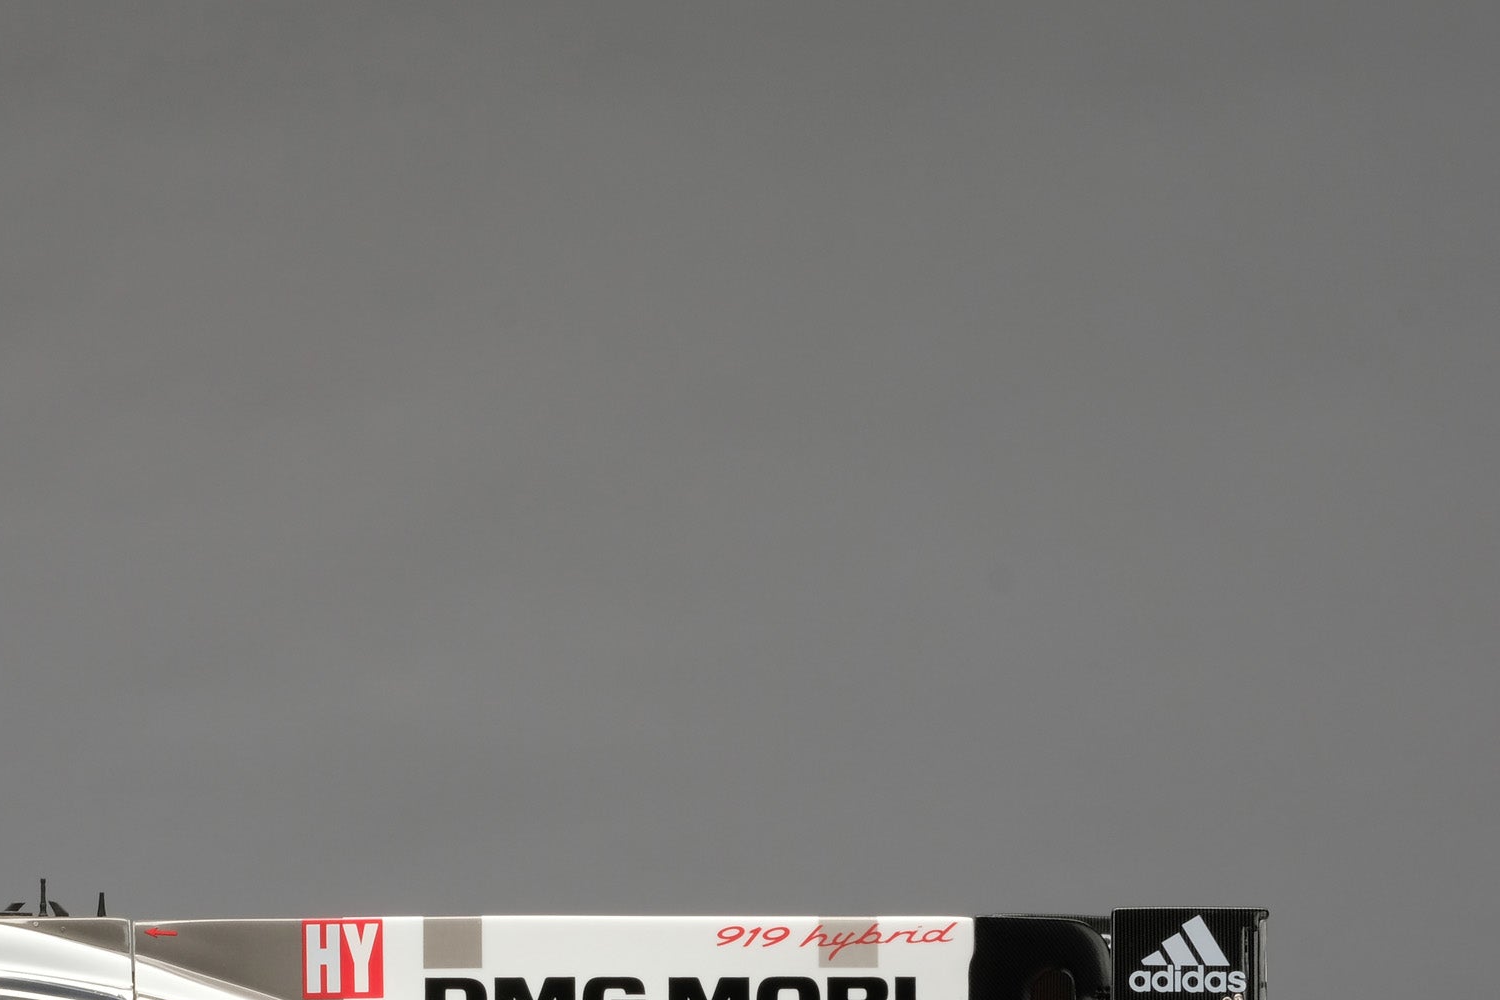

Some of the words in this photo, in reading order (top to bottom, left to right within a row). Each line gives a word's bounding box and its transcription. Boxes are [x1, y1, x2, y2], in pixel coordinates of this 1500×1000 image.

[305, 922, 381, 994] HY
[715, 926, 790, 949] 919
[799, 922, 958, 960] hybrid
[1128, 964, 1247, 993] adidas
